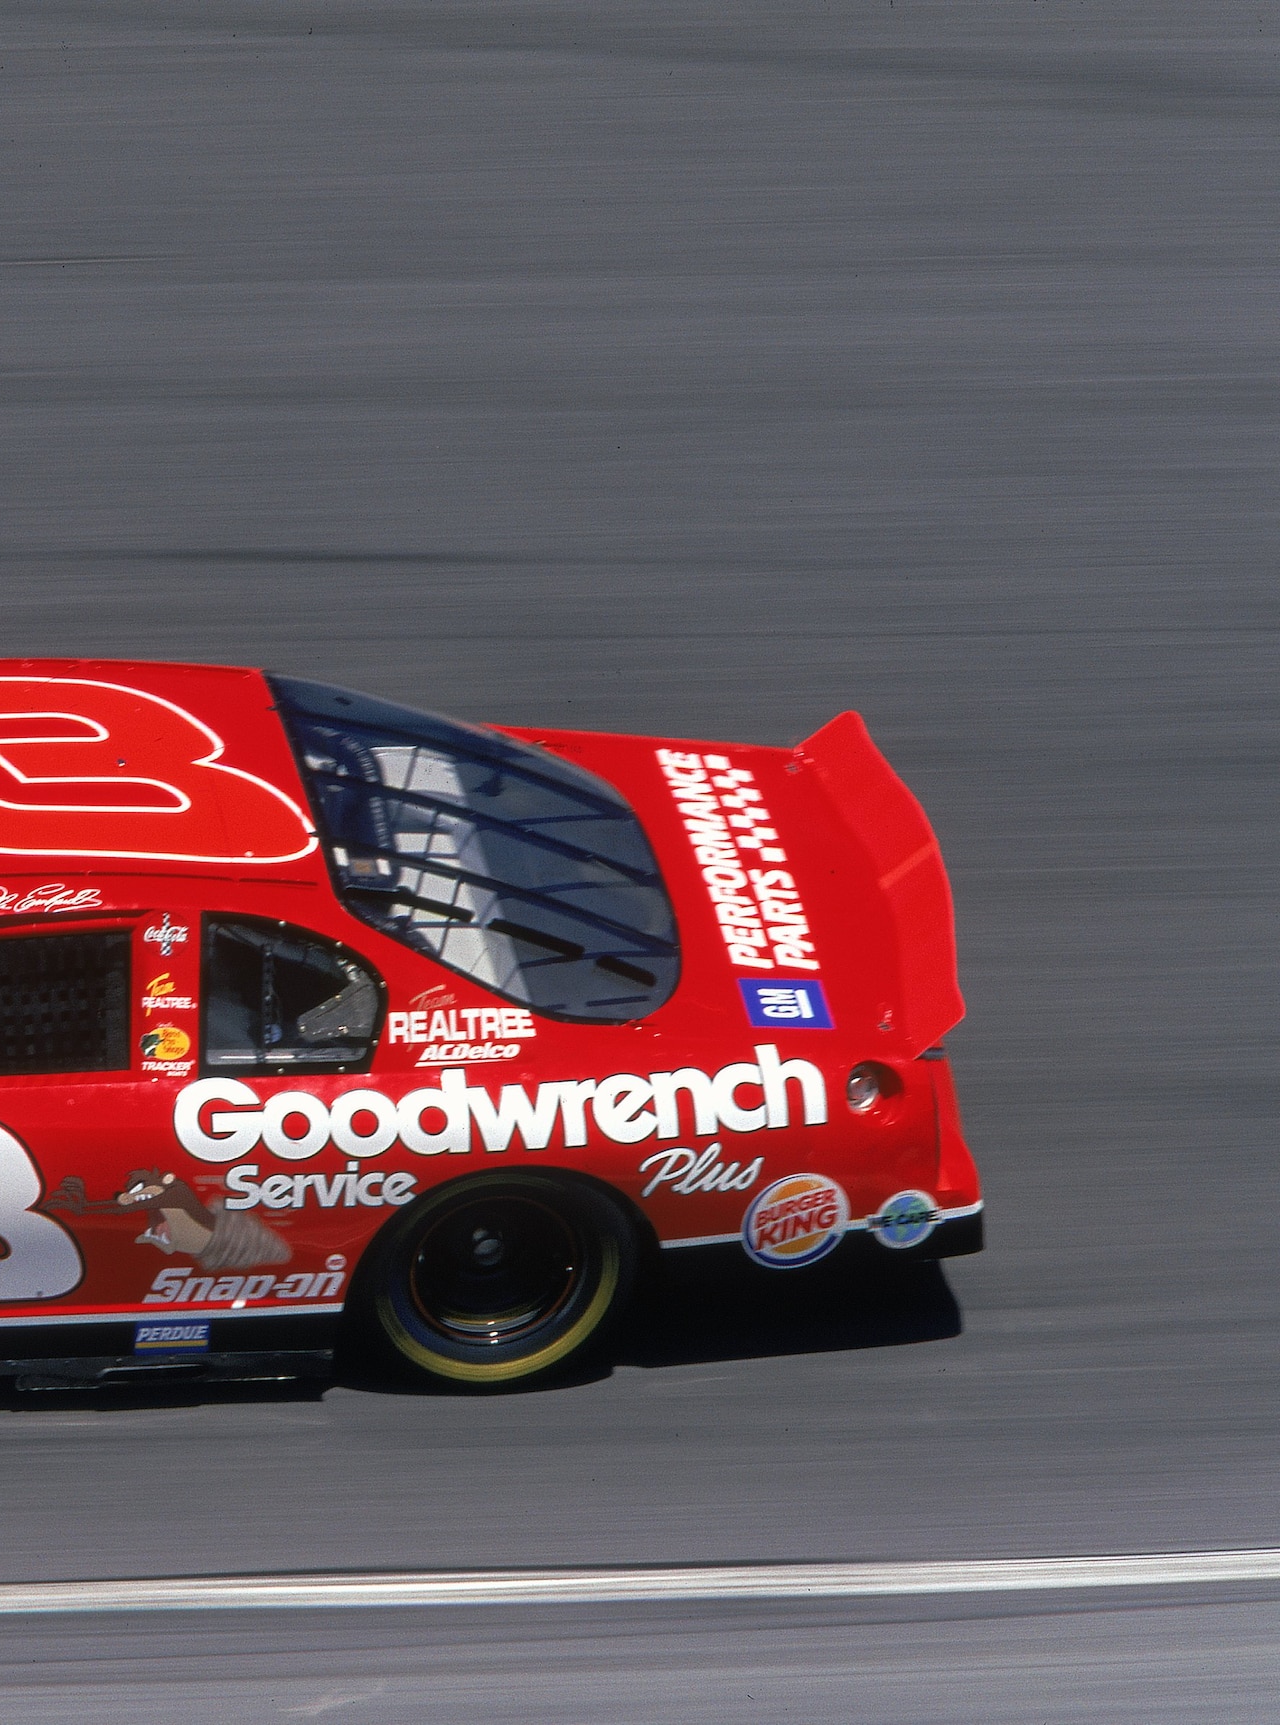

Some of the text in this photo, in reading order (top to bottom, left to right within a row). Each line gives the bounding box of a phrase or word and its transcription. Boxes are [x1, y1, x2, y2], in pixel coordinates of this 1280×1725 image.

[654, 748, 775, 969] PERFORMANCE
[748, 868, 821, 970] PARTS
[142, 997, 192, 1009] REALTREE
[757, 988, 802, 1018] GM
[388, 1007, 537, 1044] REALTREE
[141, 1061, 191, 1071] TRACKER
[418, 1042, 521, 1061] ACDelco
[173, 1043, 829, 1163] Goodwrench
[224, 1160, 421, 1211] Service
[638, 1142, 766, 1198] Plus
[756, 1188, 836, 1225] BURGER
[753, 1204, 838, 1252] KING
[141, 1266, 347, 1304] Snap-on
[135, 1325, 210, 1343] PERDUE
